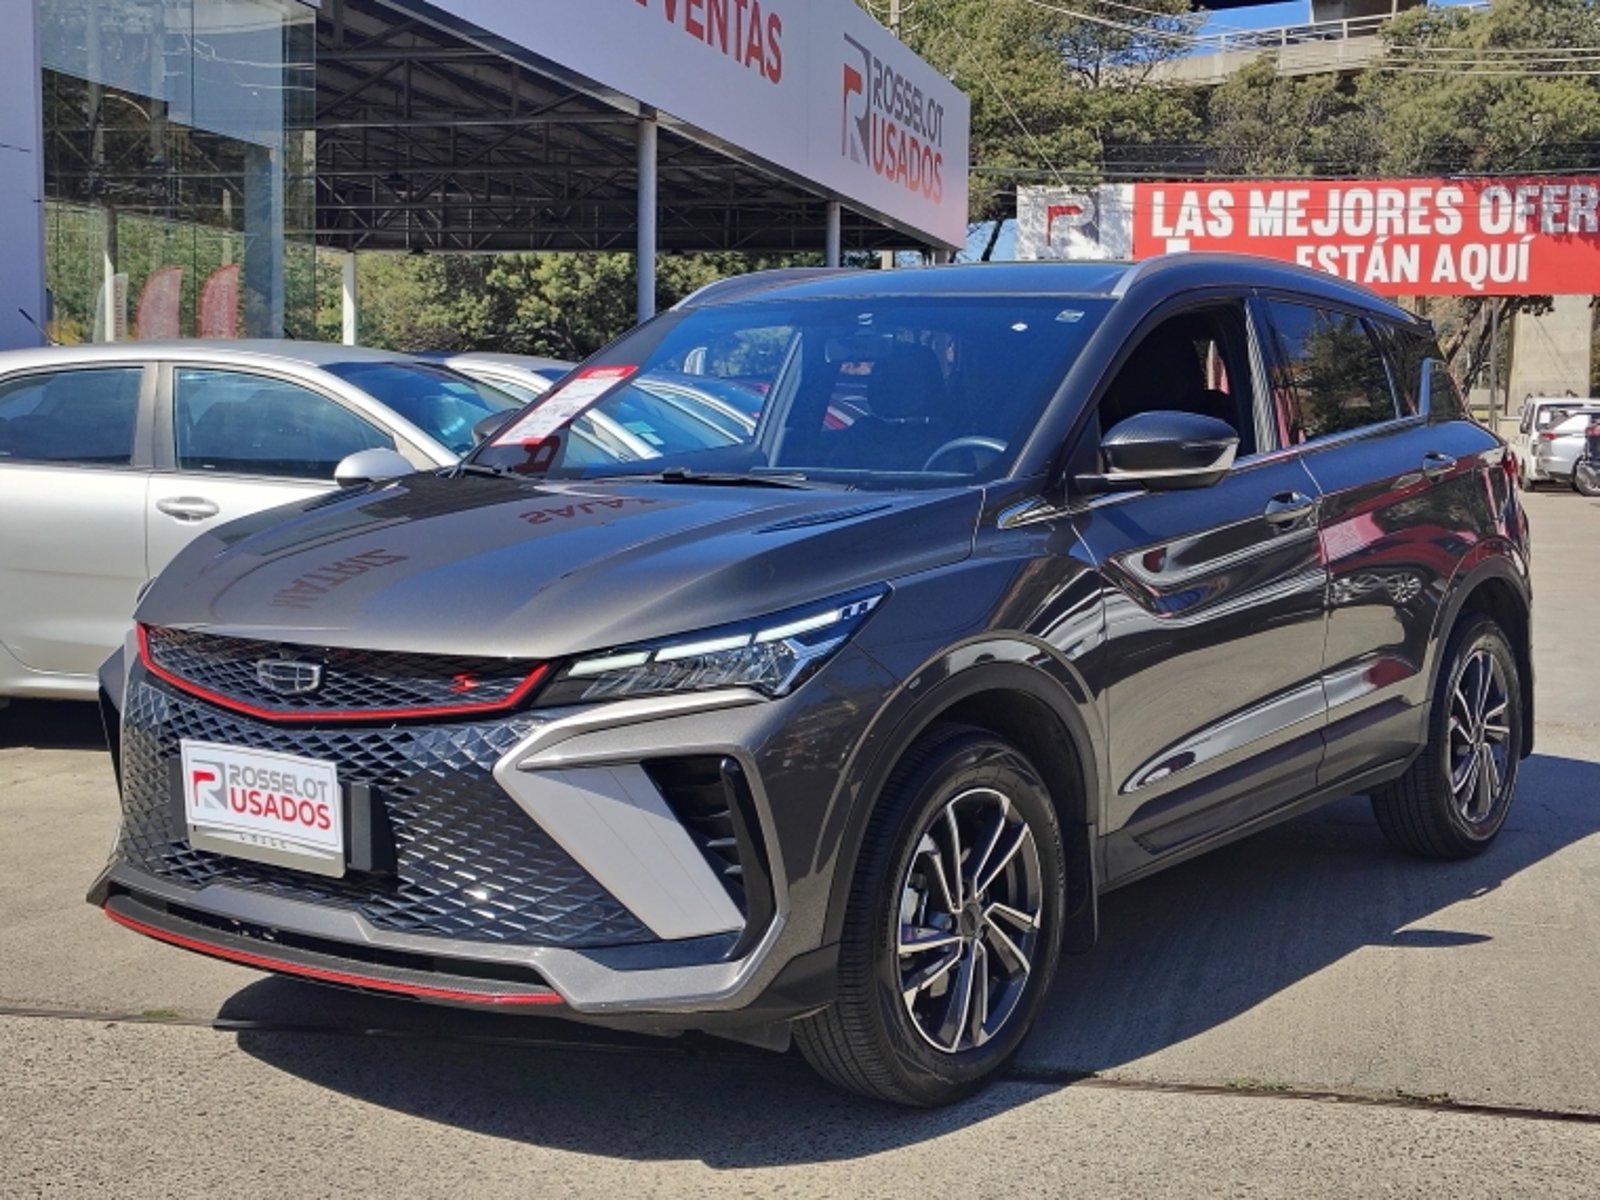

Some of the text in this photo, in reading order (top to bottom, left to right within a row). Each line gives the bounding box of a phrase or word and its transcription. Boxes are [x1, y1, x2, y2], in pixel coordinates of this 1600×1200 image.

[873, 56, 944, 148] ROSSELOT
[869, 113, 943, 205] USADOS
[1152, 189, 1235, 238] LAS
[1248, 186, 1464, 237] MEJORES
[1431, 234, 1536, 291] AQUÍ
[229, 764, 328, 802] ROSSELOT
[230, 788, 331, 830] USADOS
